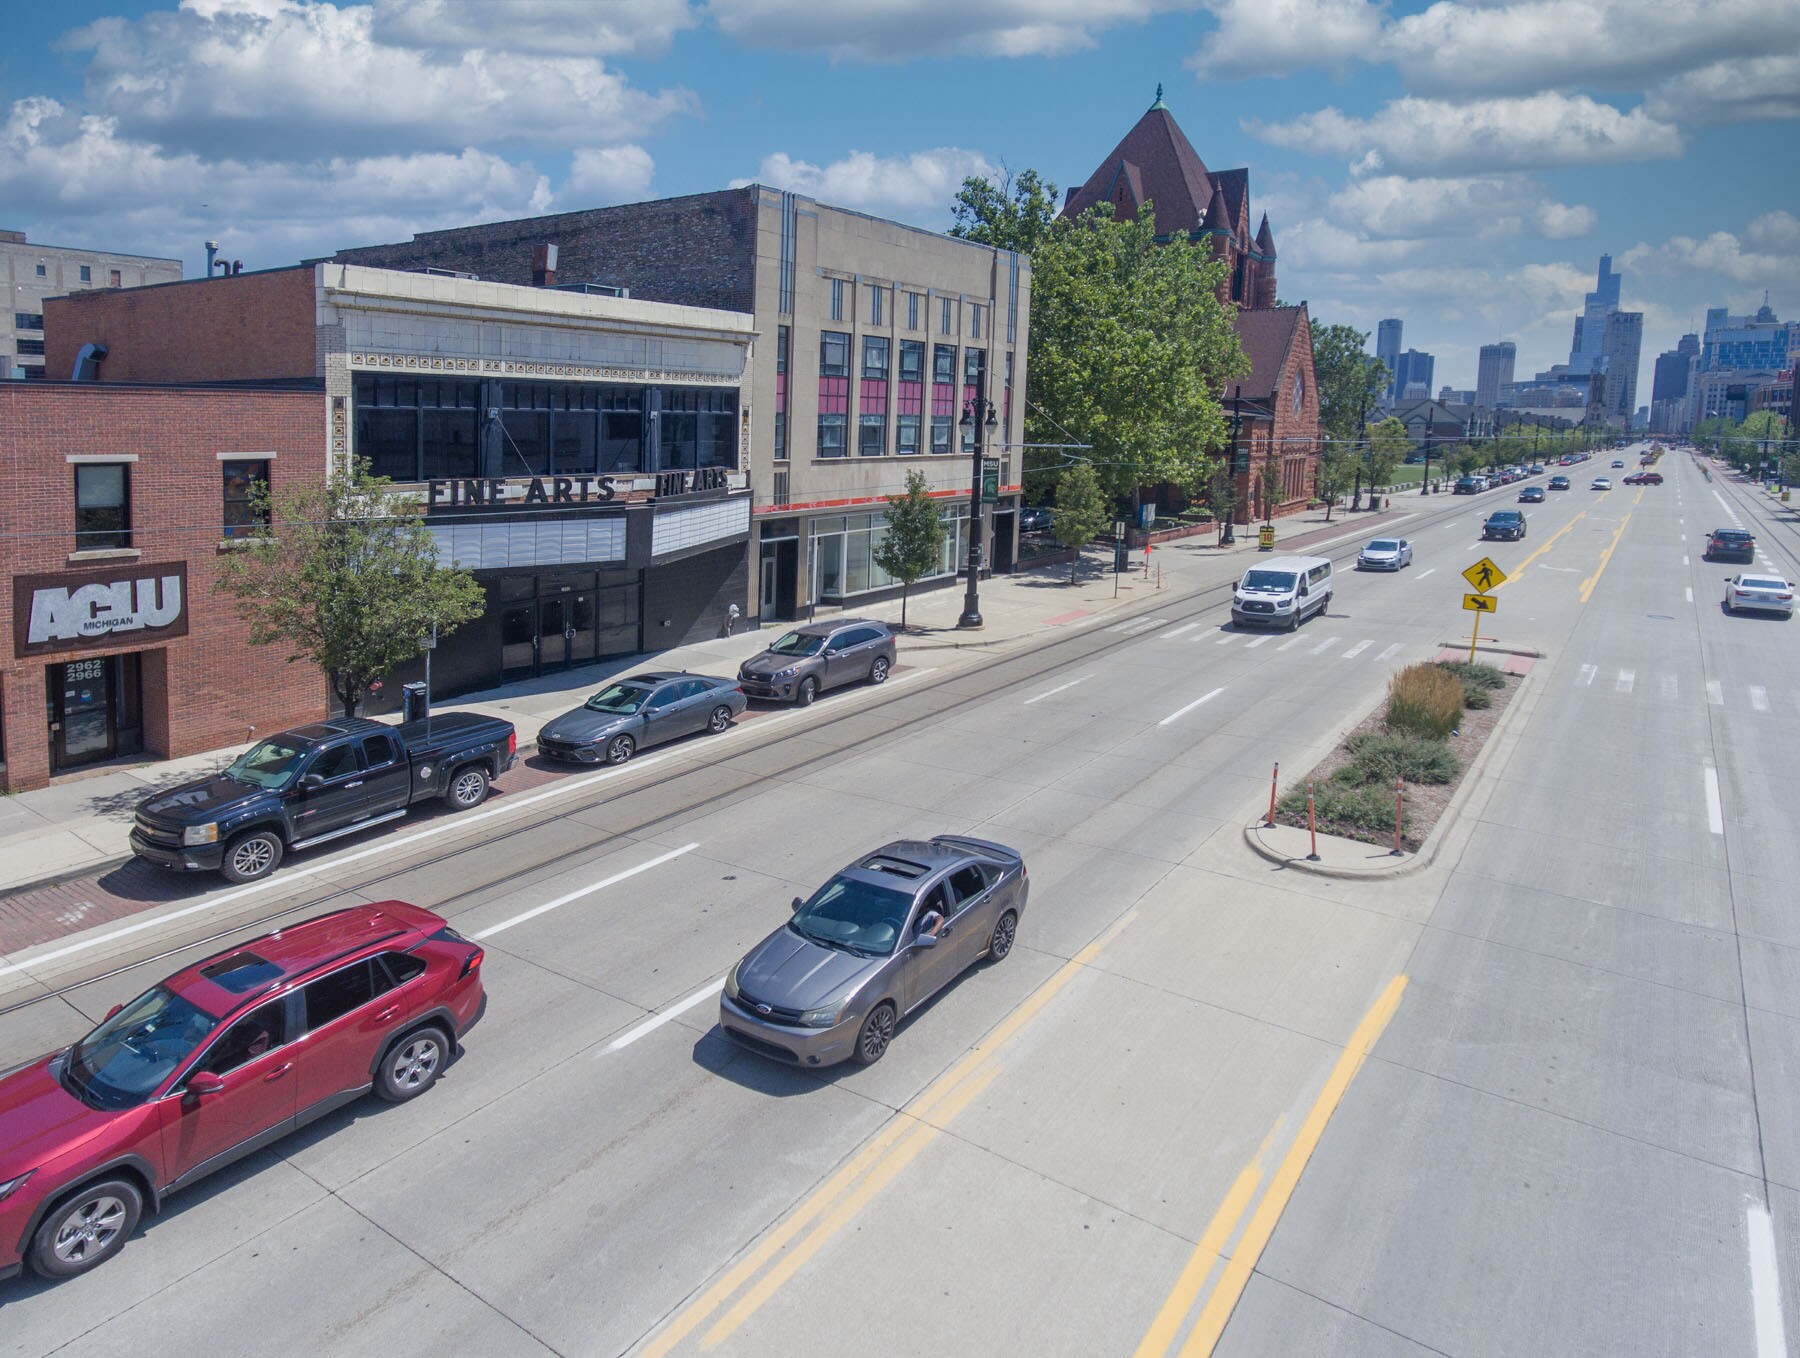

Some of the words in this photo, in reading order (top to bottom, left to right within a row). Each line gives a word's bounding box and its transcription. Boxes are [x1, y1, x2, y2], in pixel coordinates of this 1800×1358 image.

[429, 479, 506, 505] FINE
[525, 476, 616, 503] ARTS
[656, 470, 689, 497] FINE
[692, 467, 728, 492] ARTS
[28, 576, 181, 643] ACLU
[84, 617, 133, 630] MICHIGAN
[67, 669, 102, 682] 2966
